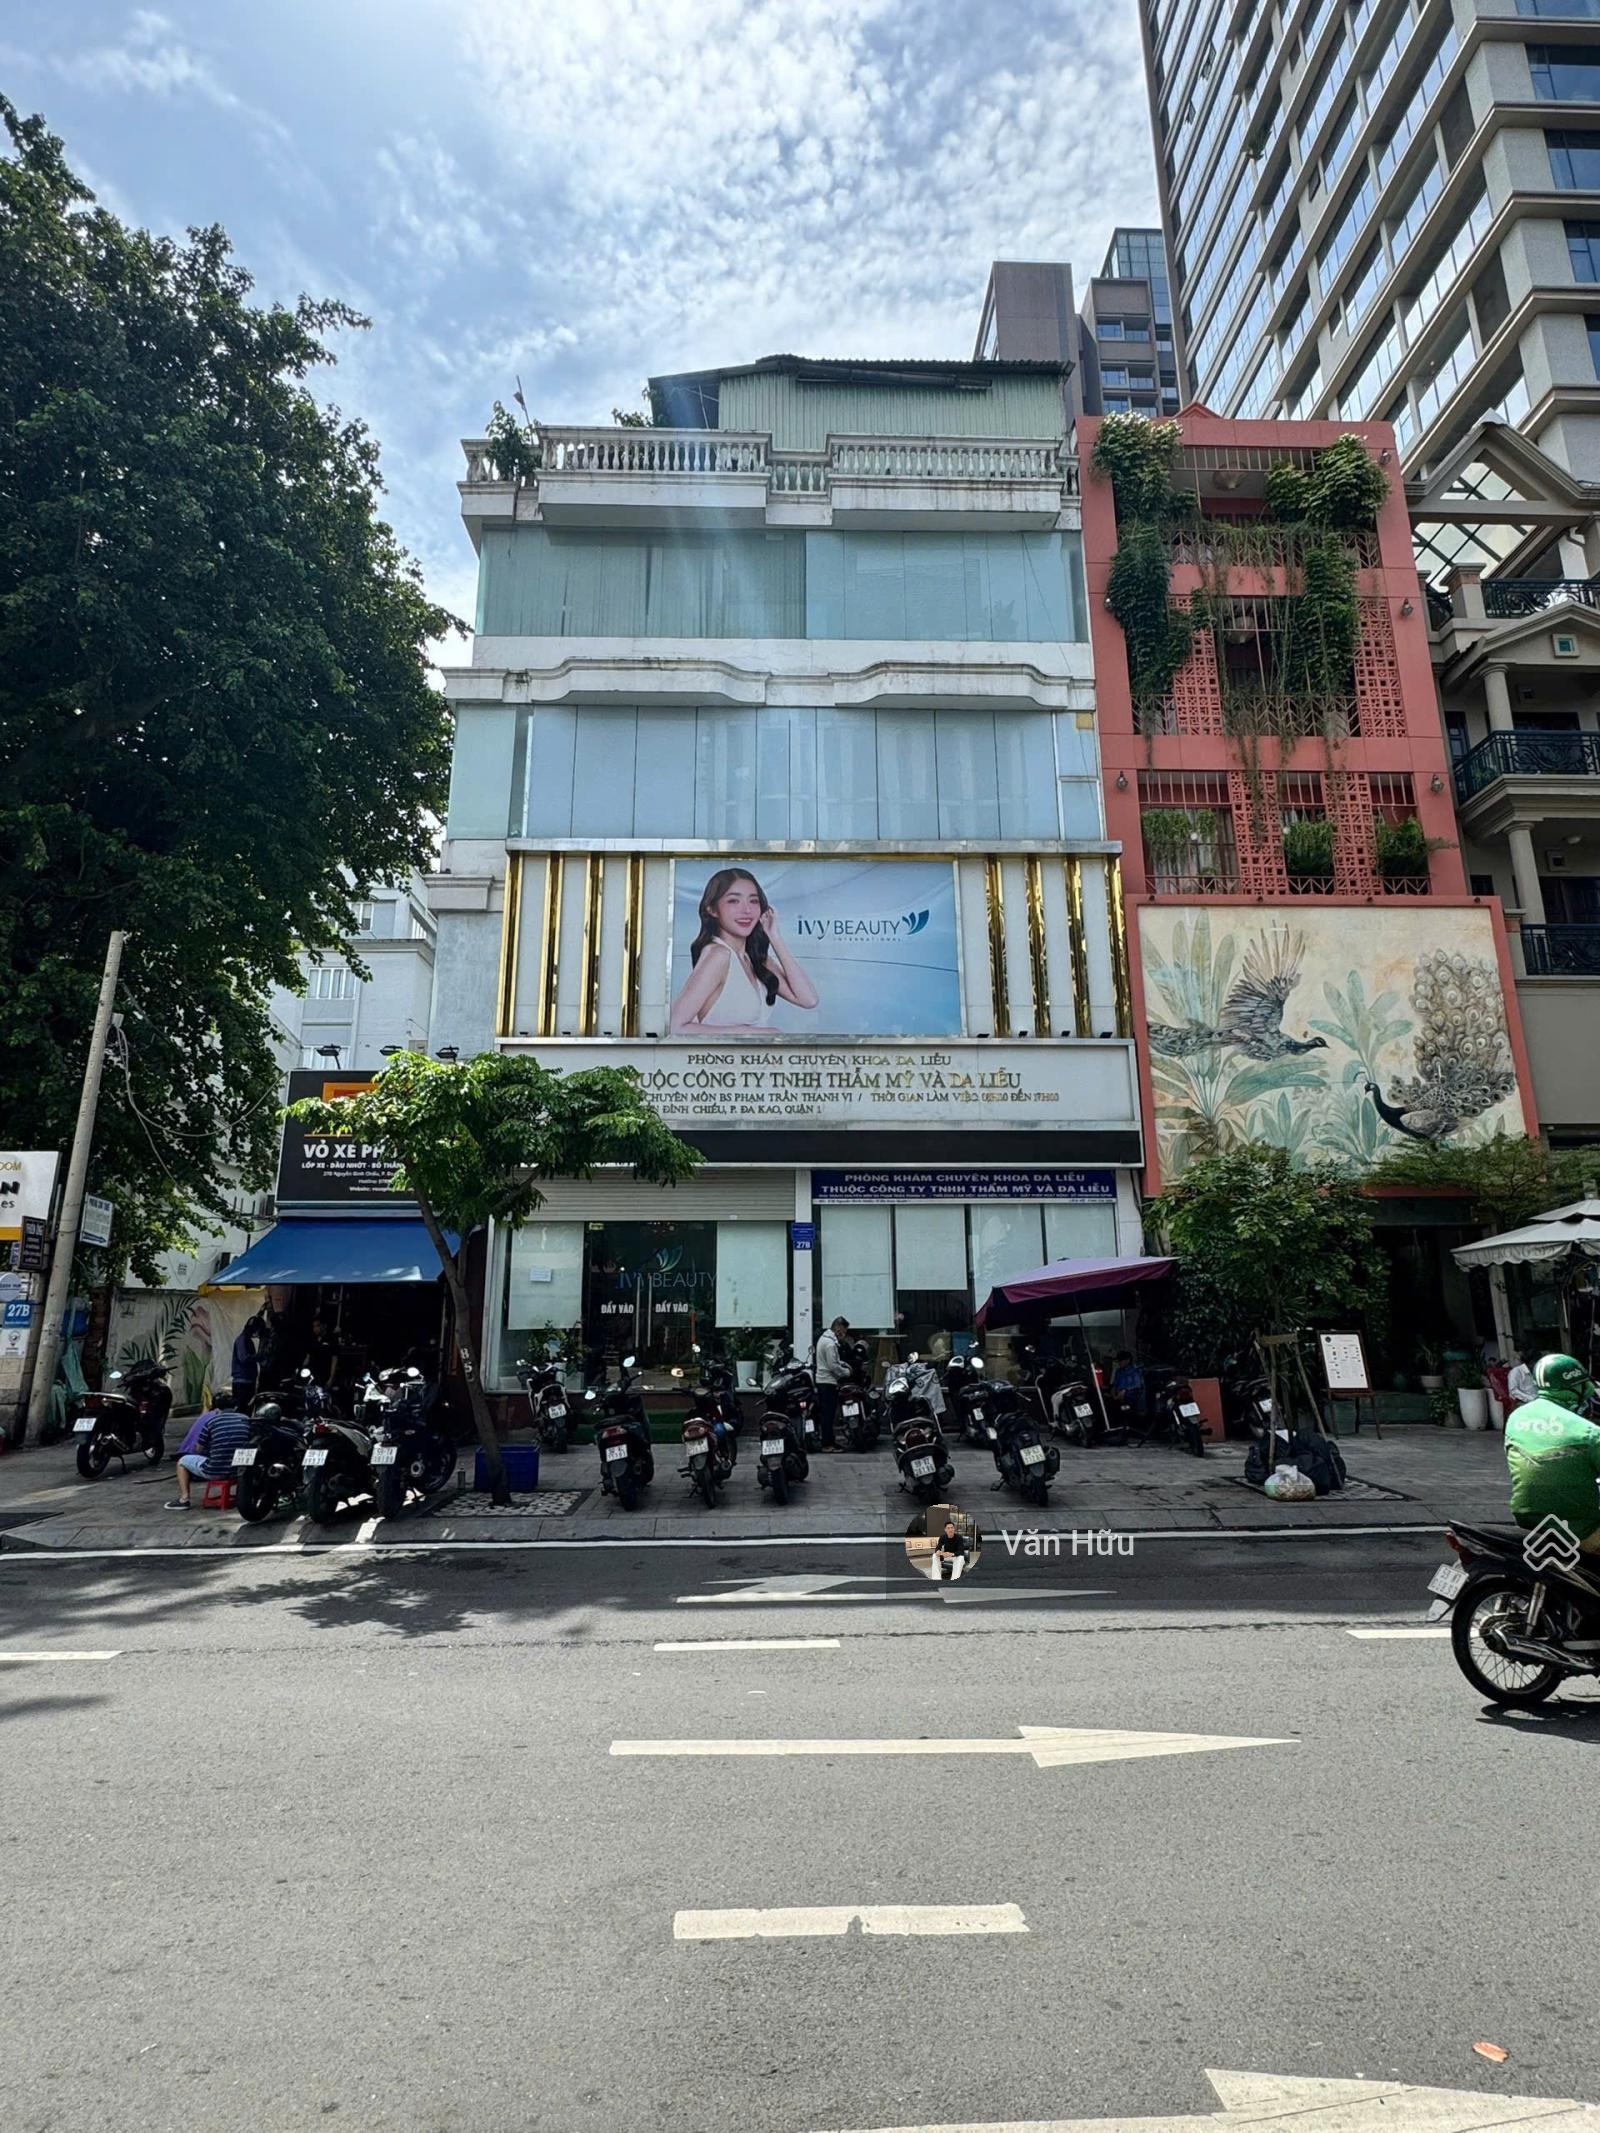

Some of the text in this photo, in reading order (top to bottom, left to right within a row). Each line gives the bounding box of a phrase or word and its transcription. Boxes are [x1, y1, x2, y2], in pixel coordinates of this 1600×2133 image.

[834, 920, 900, 935] BEAUTY
[687, 1053, 735, 1065] PHÒNG
[740, 1053, 783, 1065] KHÁM
[788, 1054, 846, 1066] CHUYÊN
[852, 1055, 890, 1065] KHOA
[683, 1068, 736, 1088] CÔNG
[741, 1072, 765, 1088] TY
[770, 1072, 821, 1089] TNHH
[886, 1070, 914, 1088] MỸ
[920, 1070, 945, 1088] VÀ
[951, 1073, 975, 1088] DA
[690, 1090, 716, 1102] MÔN
[719, 1093, 732, 1102] BS
[734, 1093, 765, 1103] PHẠM
[802, 1093, 839, 1101] THANH
[898, 1093, 923, 1101] GIAN
[926, 1090, 949, 1101] LÀM
[730, 1105, 738, 1114] P.
[758, 1105, 782, 1115] KAO,
[785, 1104, 814, 1115] QUẬN
[303, 1139, 329, 1158] VỎ
[333, 1144, 356, 1158] XE
[844, 1173, 889, 1182] PHÒNG
[893, 1173, 932, 1182] KHÁM
[936, 1173, 989, 1182] CHUYÊN
[993, 1174, 1029, 1182] KHOA
[1033, 1174, 1052, 1182] DA
[821, 1184, 866, 1194] THUỘC
[869, 1184, 905, 1193] CÔNG
[909, 1185, 926, 1193] TY
[930, 1185, 966, 1193] TNHH
[1012, 1184, 1032, 1193] MỸ
[1036, 1184, 1054, 1193] VÀ
[1058, 1185, 1076, 1193] DA
[653, 1272, 717, 1287] BEAUTY
[7, 1304, 30, 1317] 27B
[618, 1302, 634, 1314] VÀO
[673, 1301, 689, 1313] VÀO
[1562, 1368, 1582, 1380] Grab
